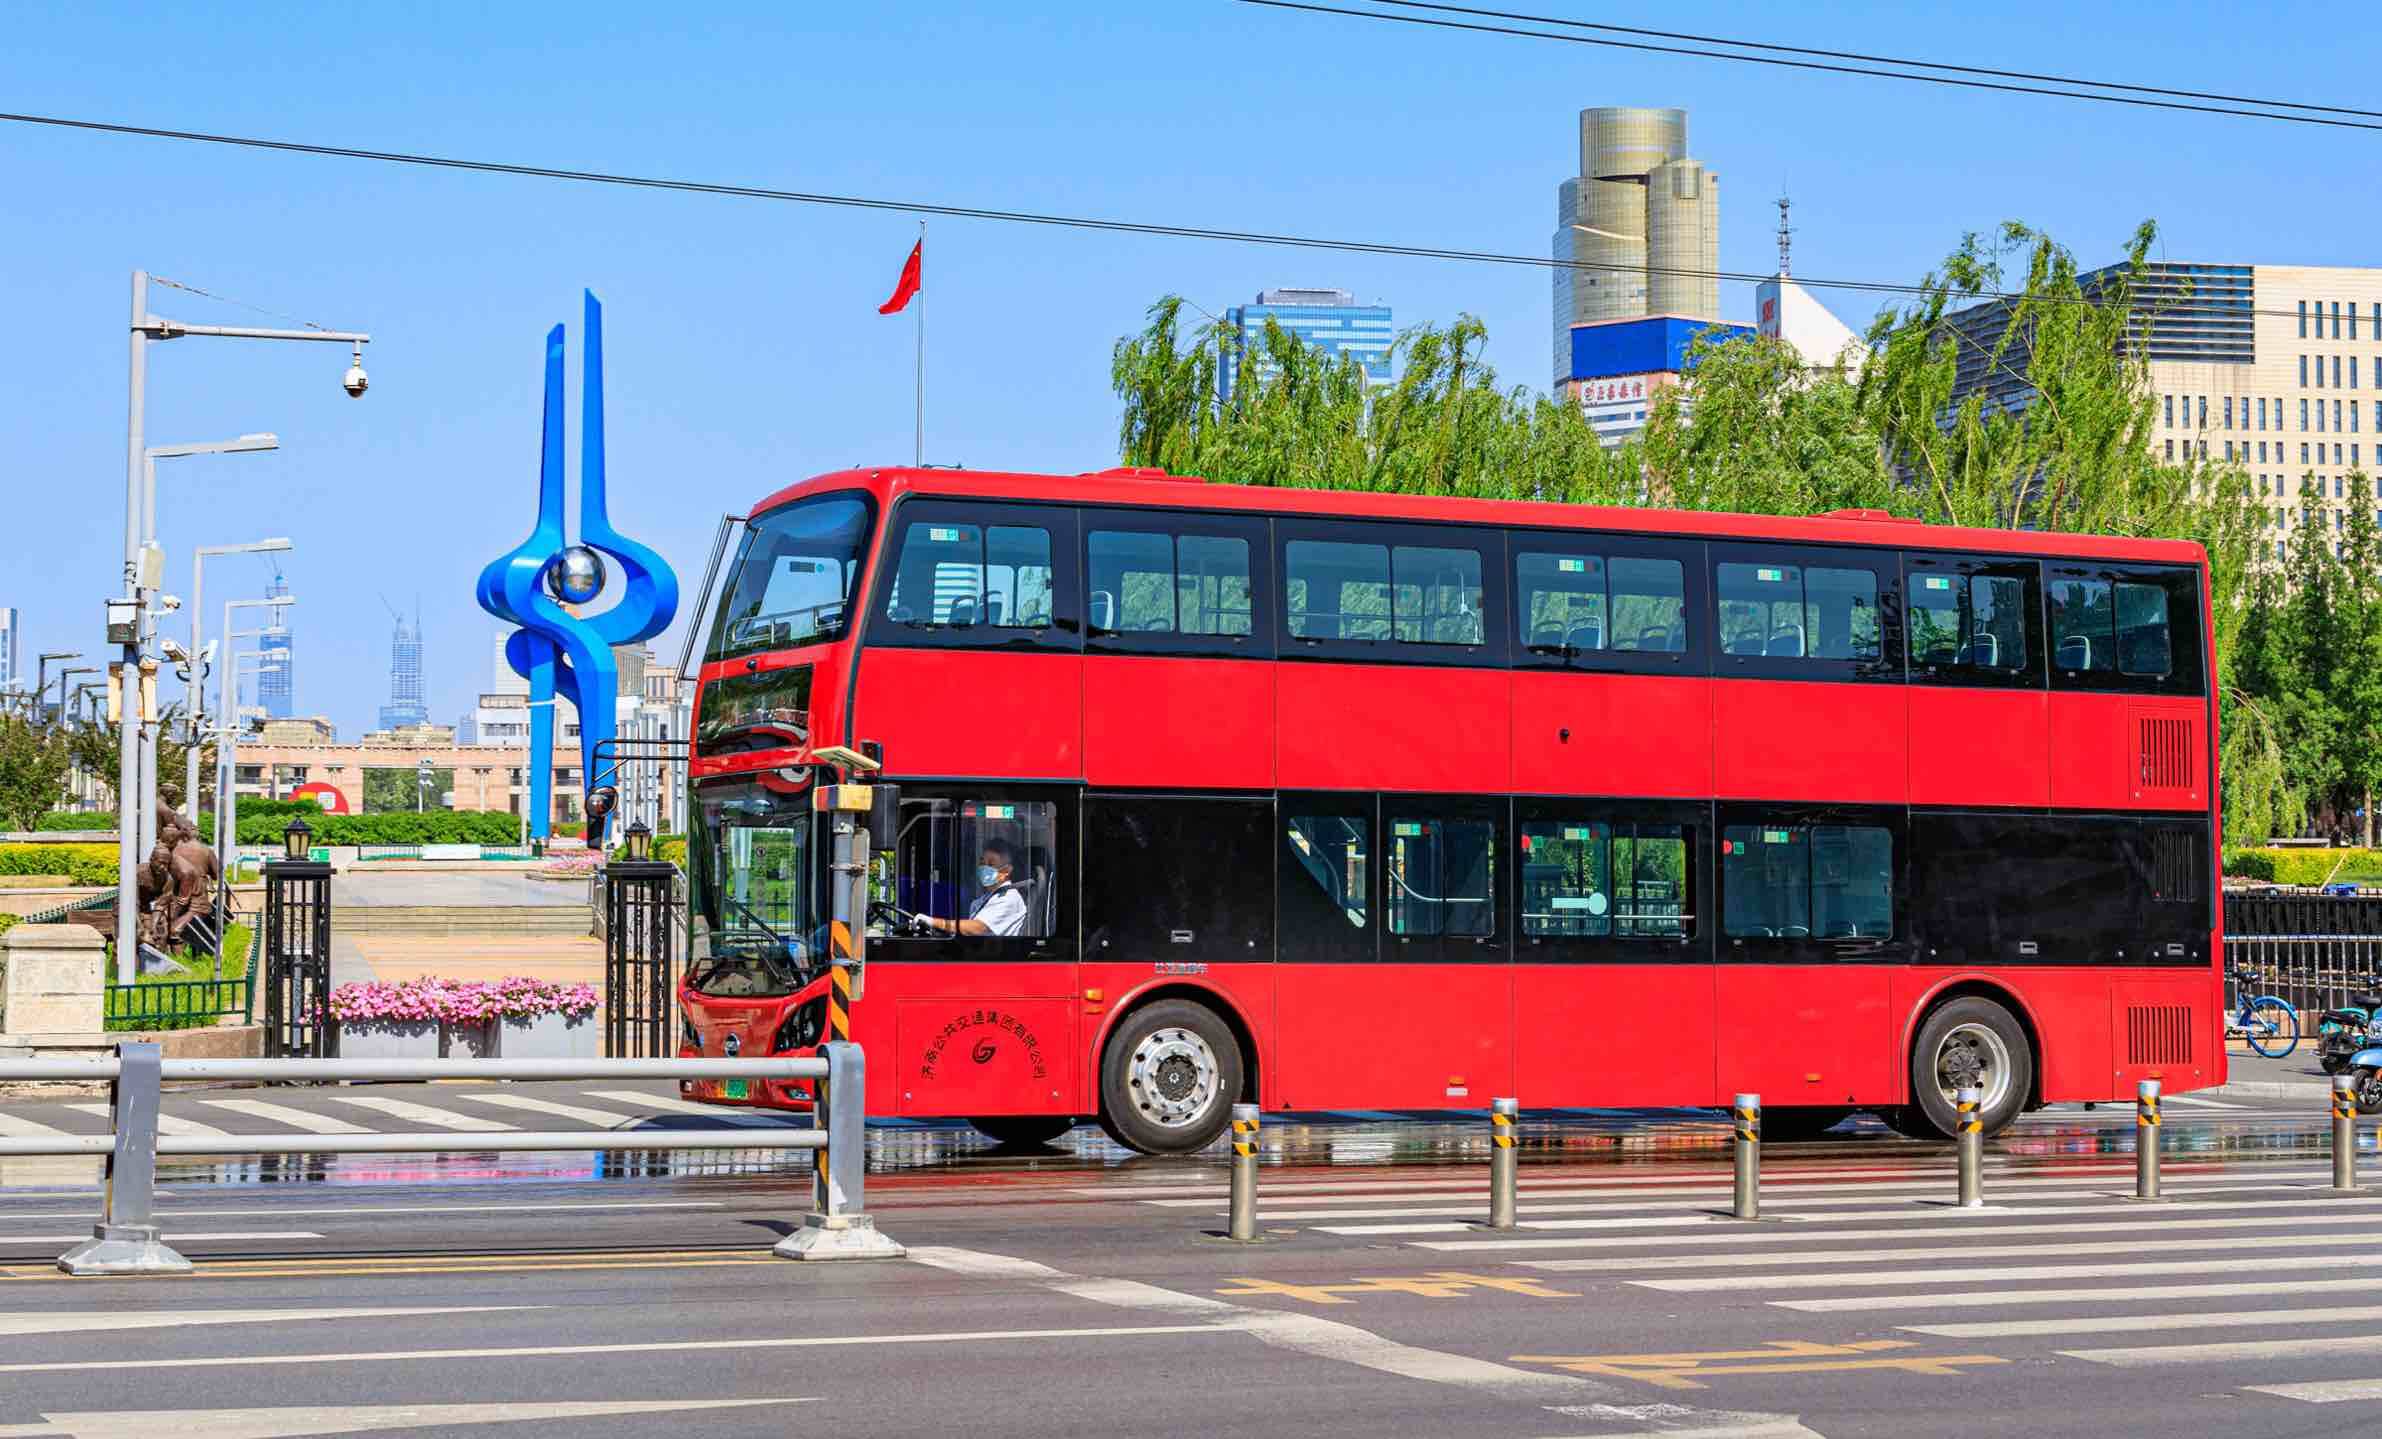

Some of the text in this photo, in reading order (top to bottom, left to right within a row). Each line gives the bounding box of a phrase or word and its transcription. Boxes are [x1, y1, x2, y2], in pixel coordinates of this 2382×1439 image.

[921, 1008, 1047, 1080] 济南公共交通集团有限公司
